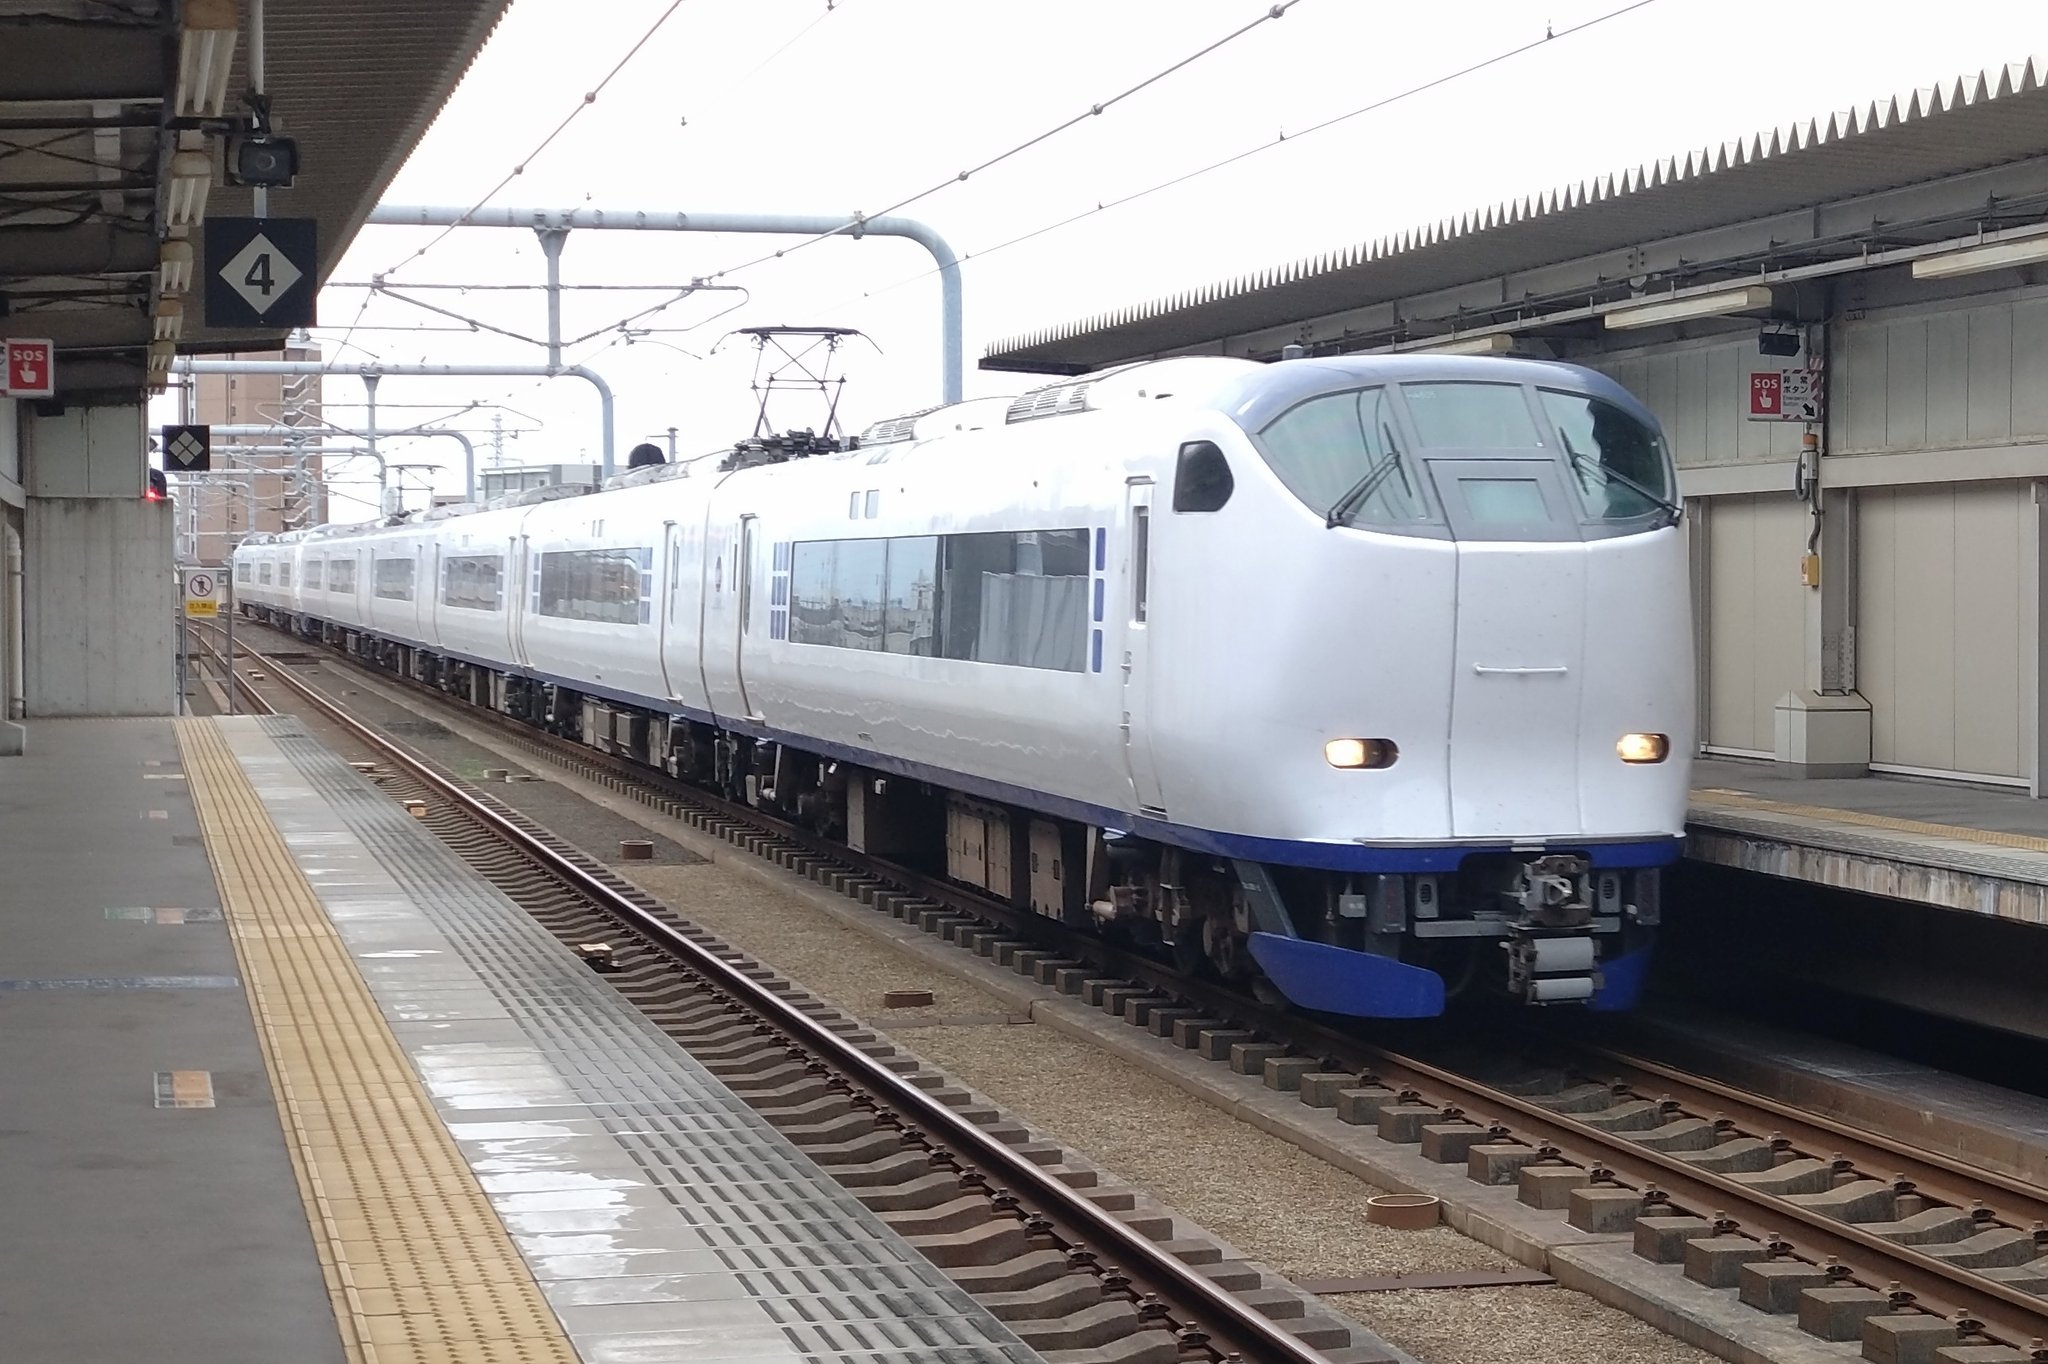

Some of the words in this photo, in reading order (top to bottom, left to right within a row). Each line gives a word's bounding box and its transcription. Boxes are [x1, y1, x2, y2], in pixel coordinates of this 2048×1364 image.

[245, 253, 275, 296] 4
[13, 350, 44, 361] SOS
[1754, 378, 1778, 389] SOS
[1783, 385, 1808, 394] ボタン
